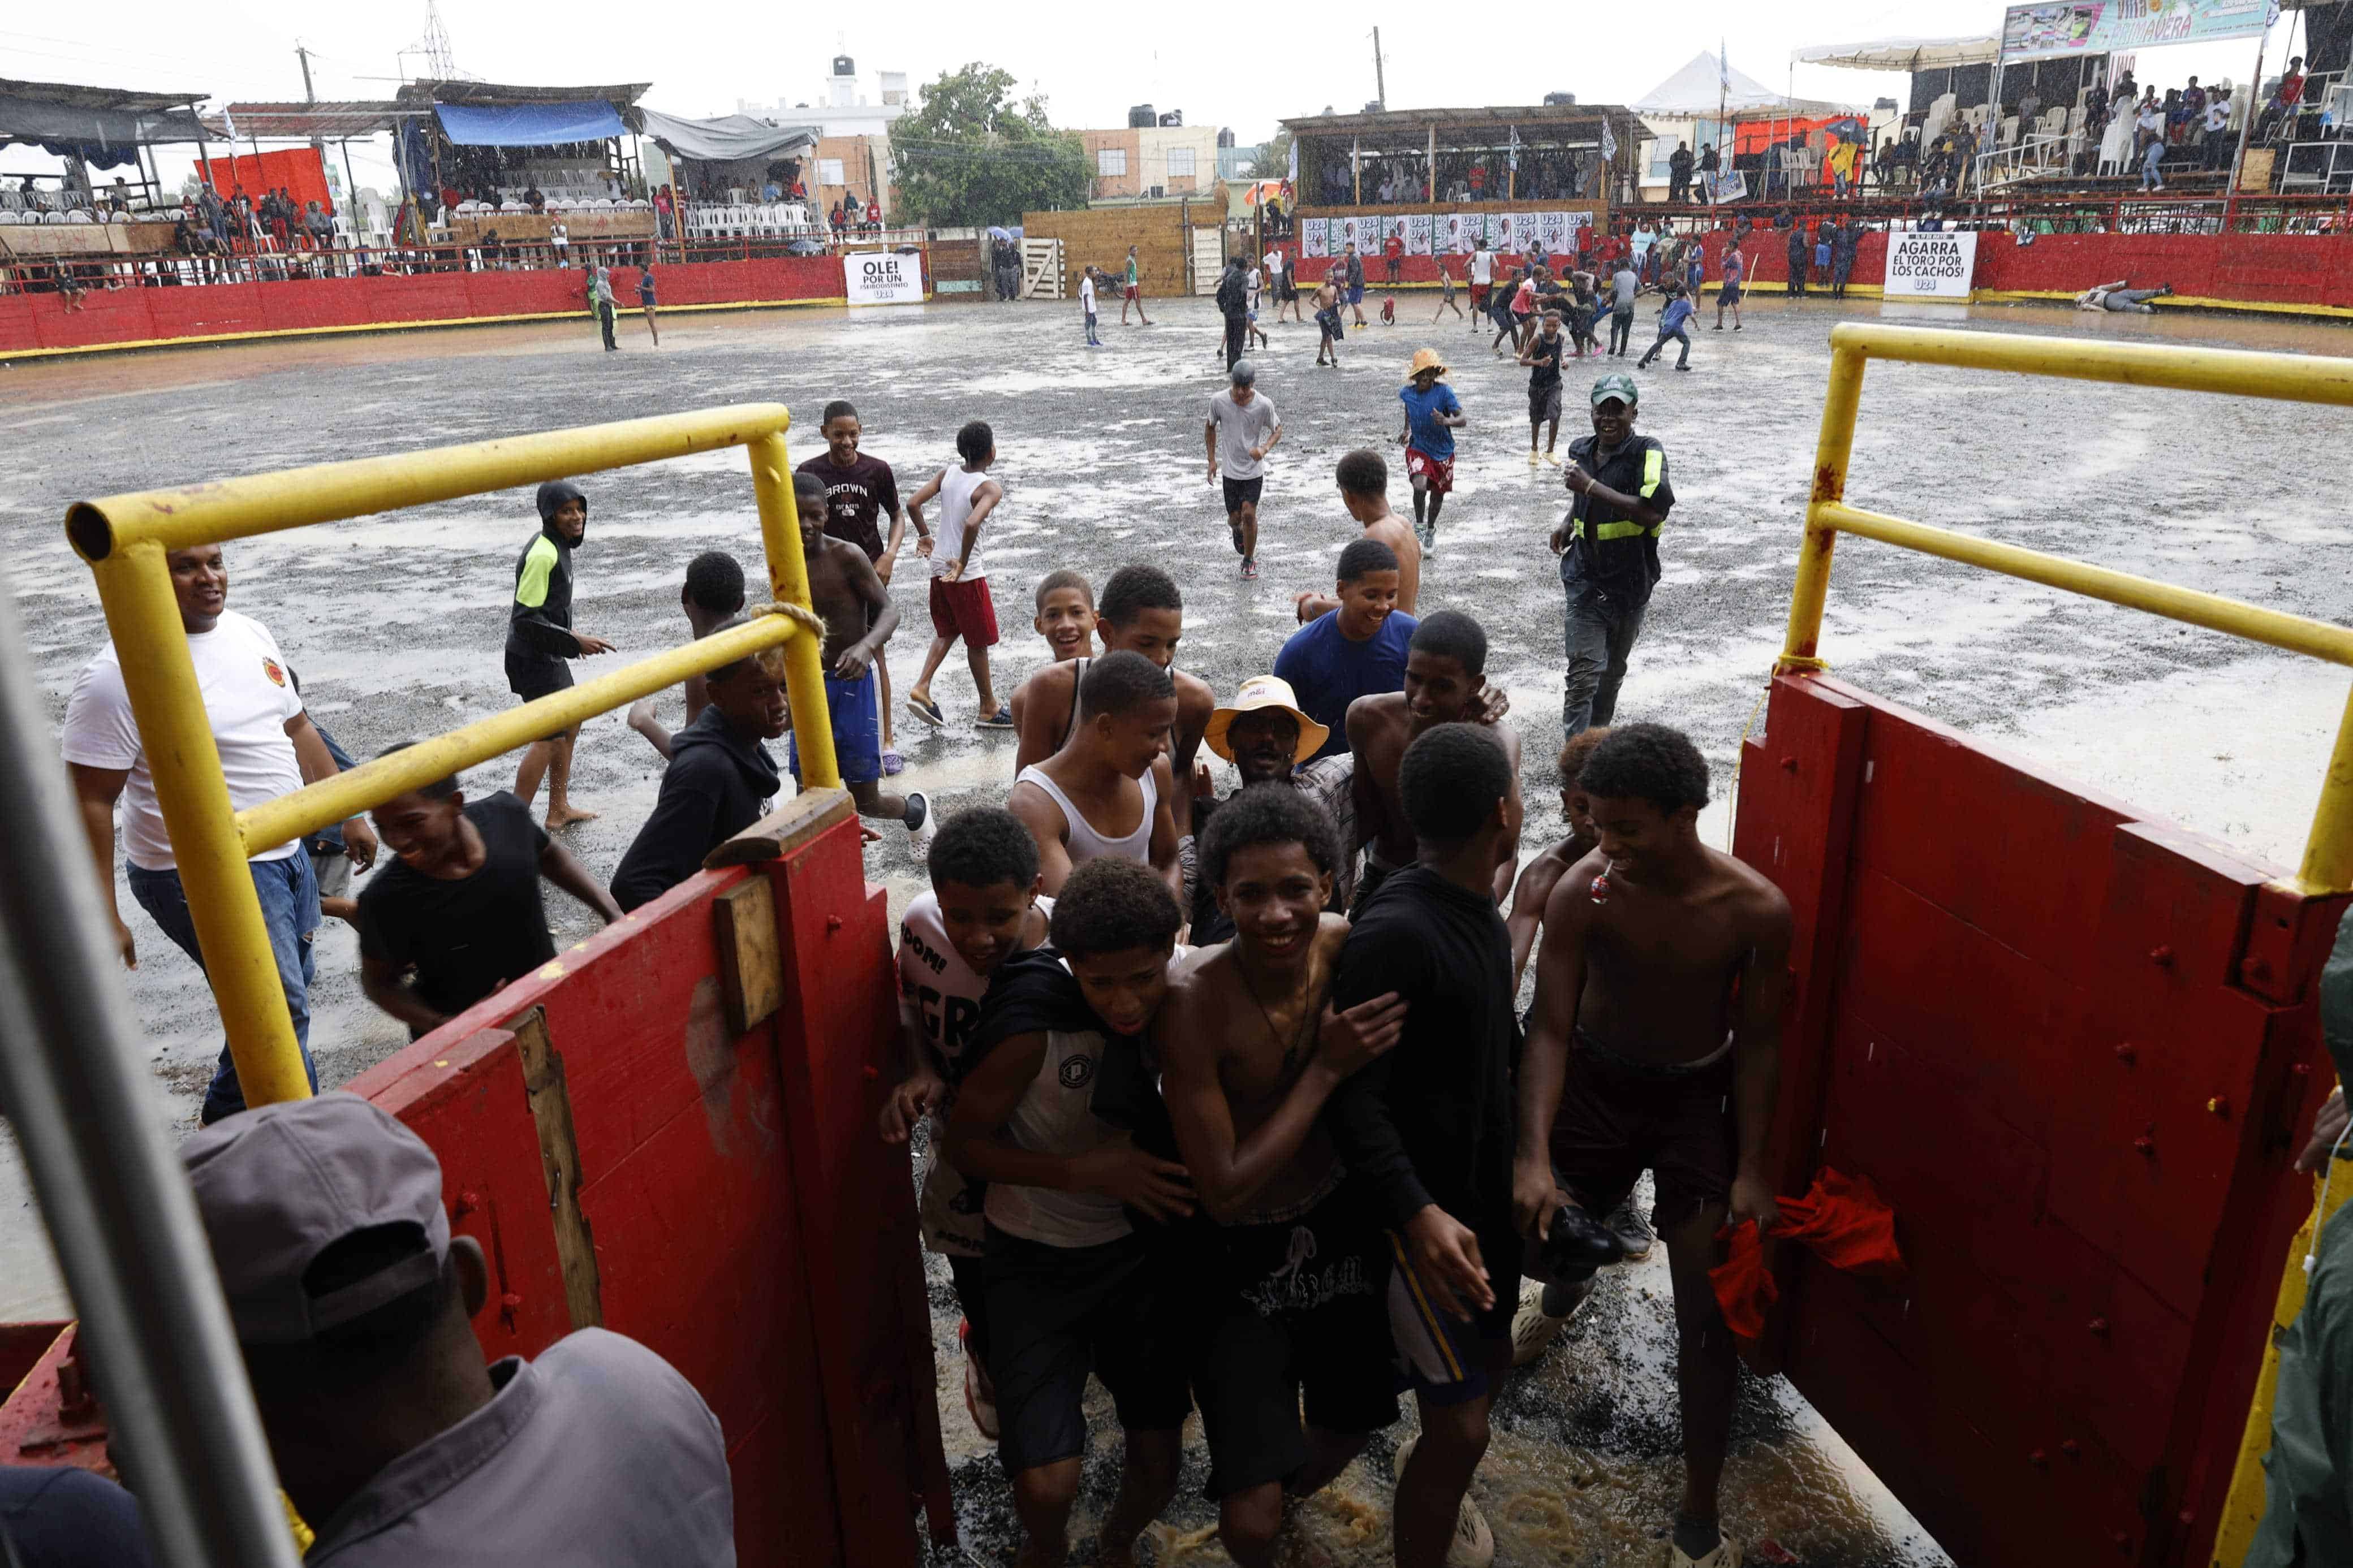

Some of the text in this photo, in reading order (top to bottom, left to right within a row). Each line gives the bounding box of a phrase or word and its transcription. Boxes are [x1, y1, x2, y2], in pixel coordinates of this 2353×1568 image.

[2109, 14, 2191, 45] PRIMAVERA
[1306, 220, 1326, 230] U24
[1358, 217, 1379, 228] U24
[1410, 216, 1430, 227] U24
[1462, 215, 1483, 226] U24
[1514, 214, 1535, 225] U24
[1541, 214, 1562, 225] U24
[1898, 242, 1959, 254] AGARRA
[863, 257, 898, 275] OLÉ!
[1894, 256, 1962, 266] EL TORO POR
[1893, 266, 1964, 277] LOS CACHOS!
[1914, 279, 1936, 290] U24
[825, 483, 868, 498] BROWN
